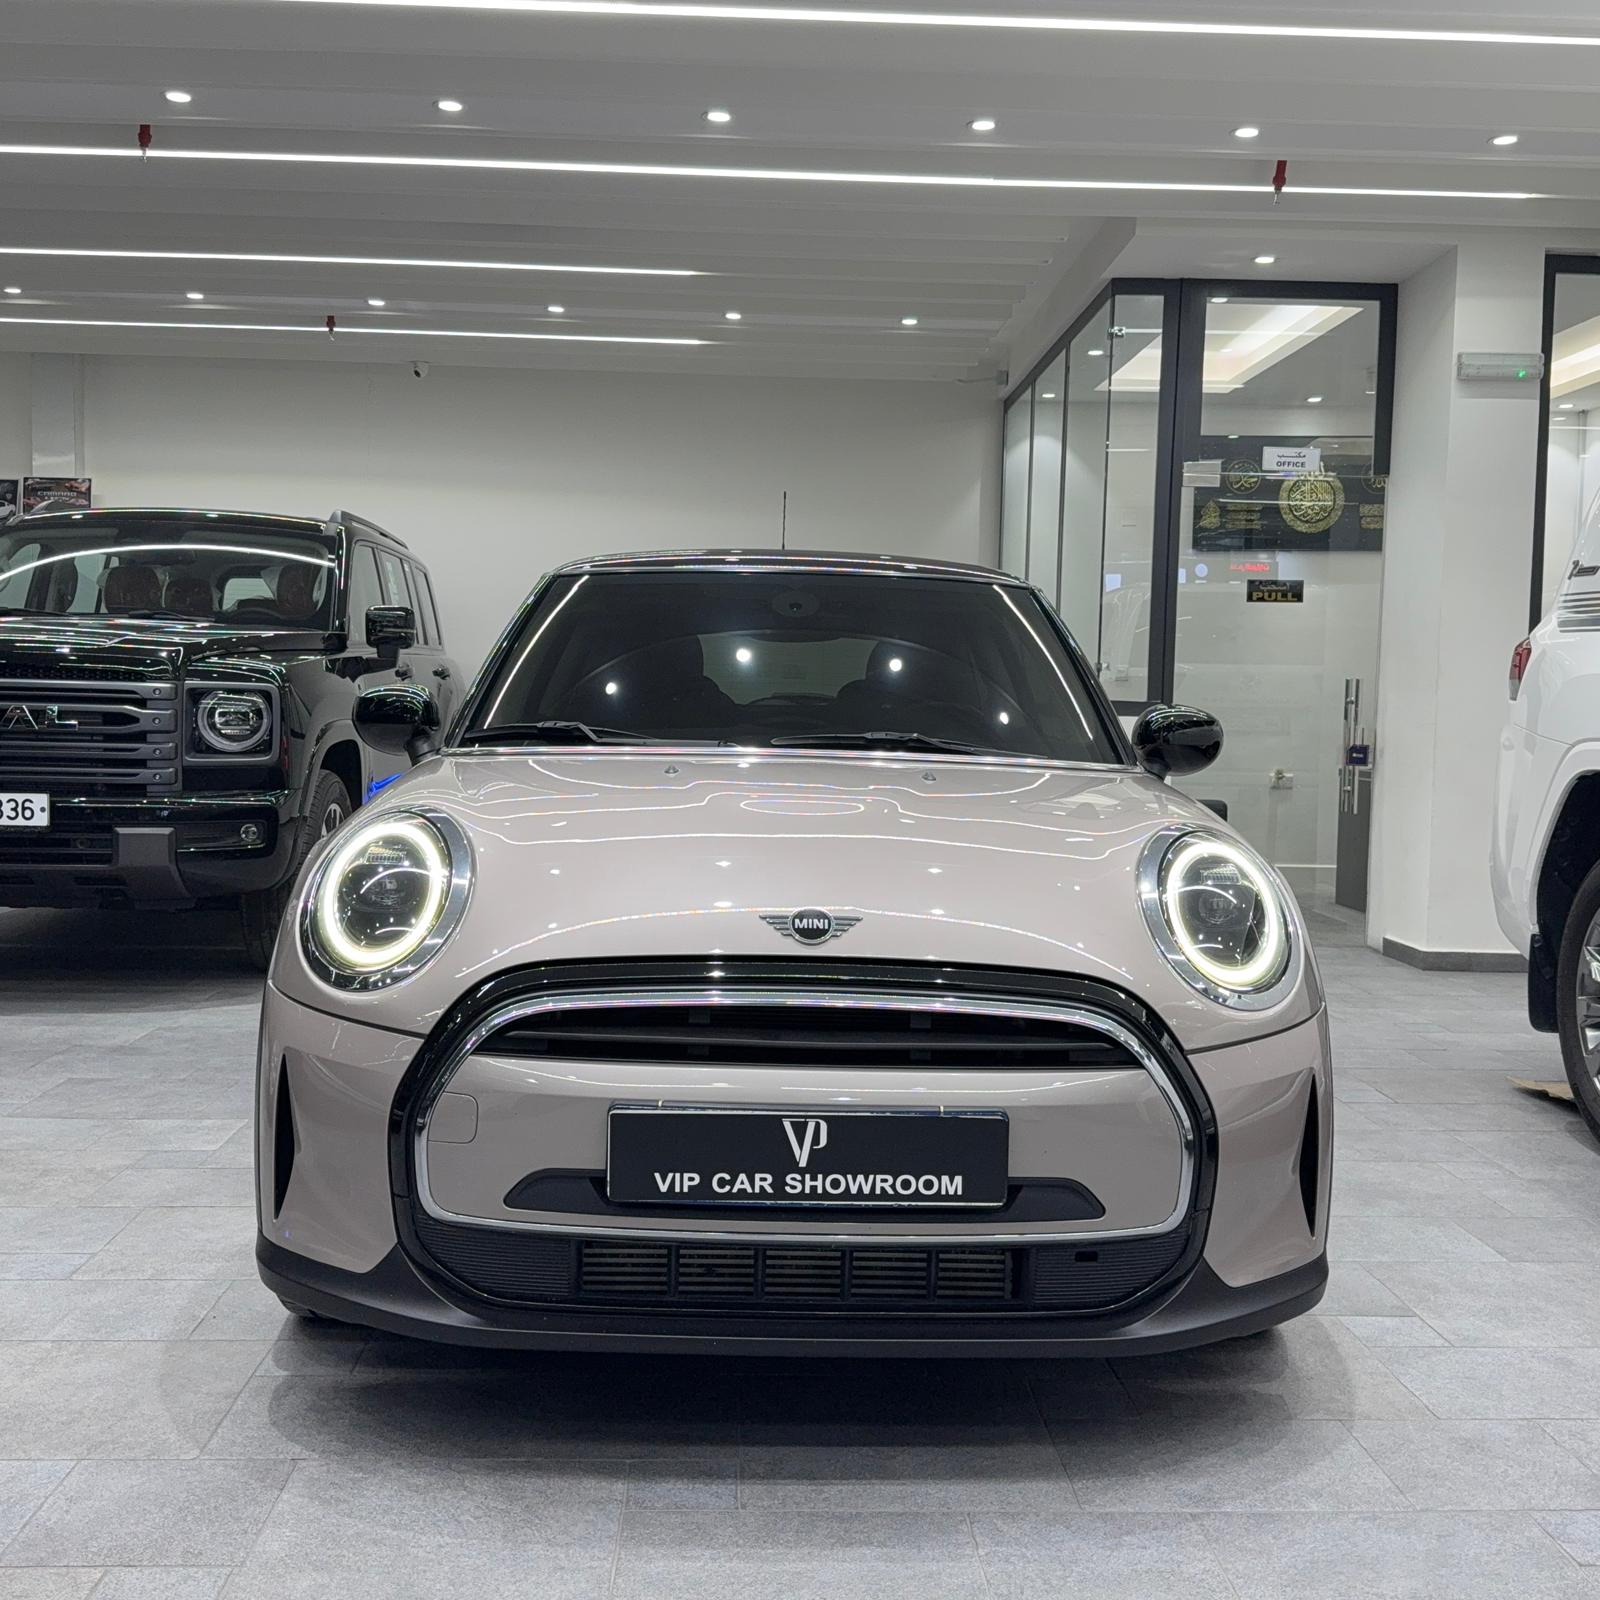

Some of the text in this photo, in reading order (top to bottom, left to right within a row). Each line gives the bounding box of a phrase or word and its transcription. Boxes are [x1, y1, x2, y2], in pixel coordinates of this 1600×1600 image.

[1275, 460, 1307, 469] OFFICE
[1252, 592, 1298, 601] PULL
[0, 798, 35, 821] 36
[794, 918, 829, 929] MINI
[653, 1172, 963, 1196] VIP CAR SHOWROOM
